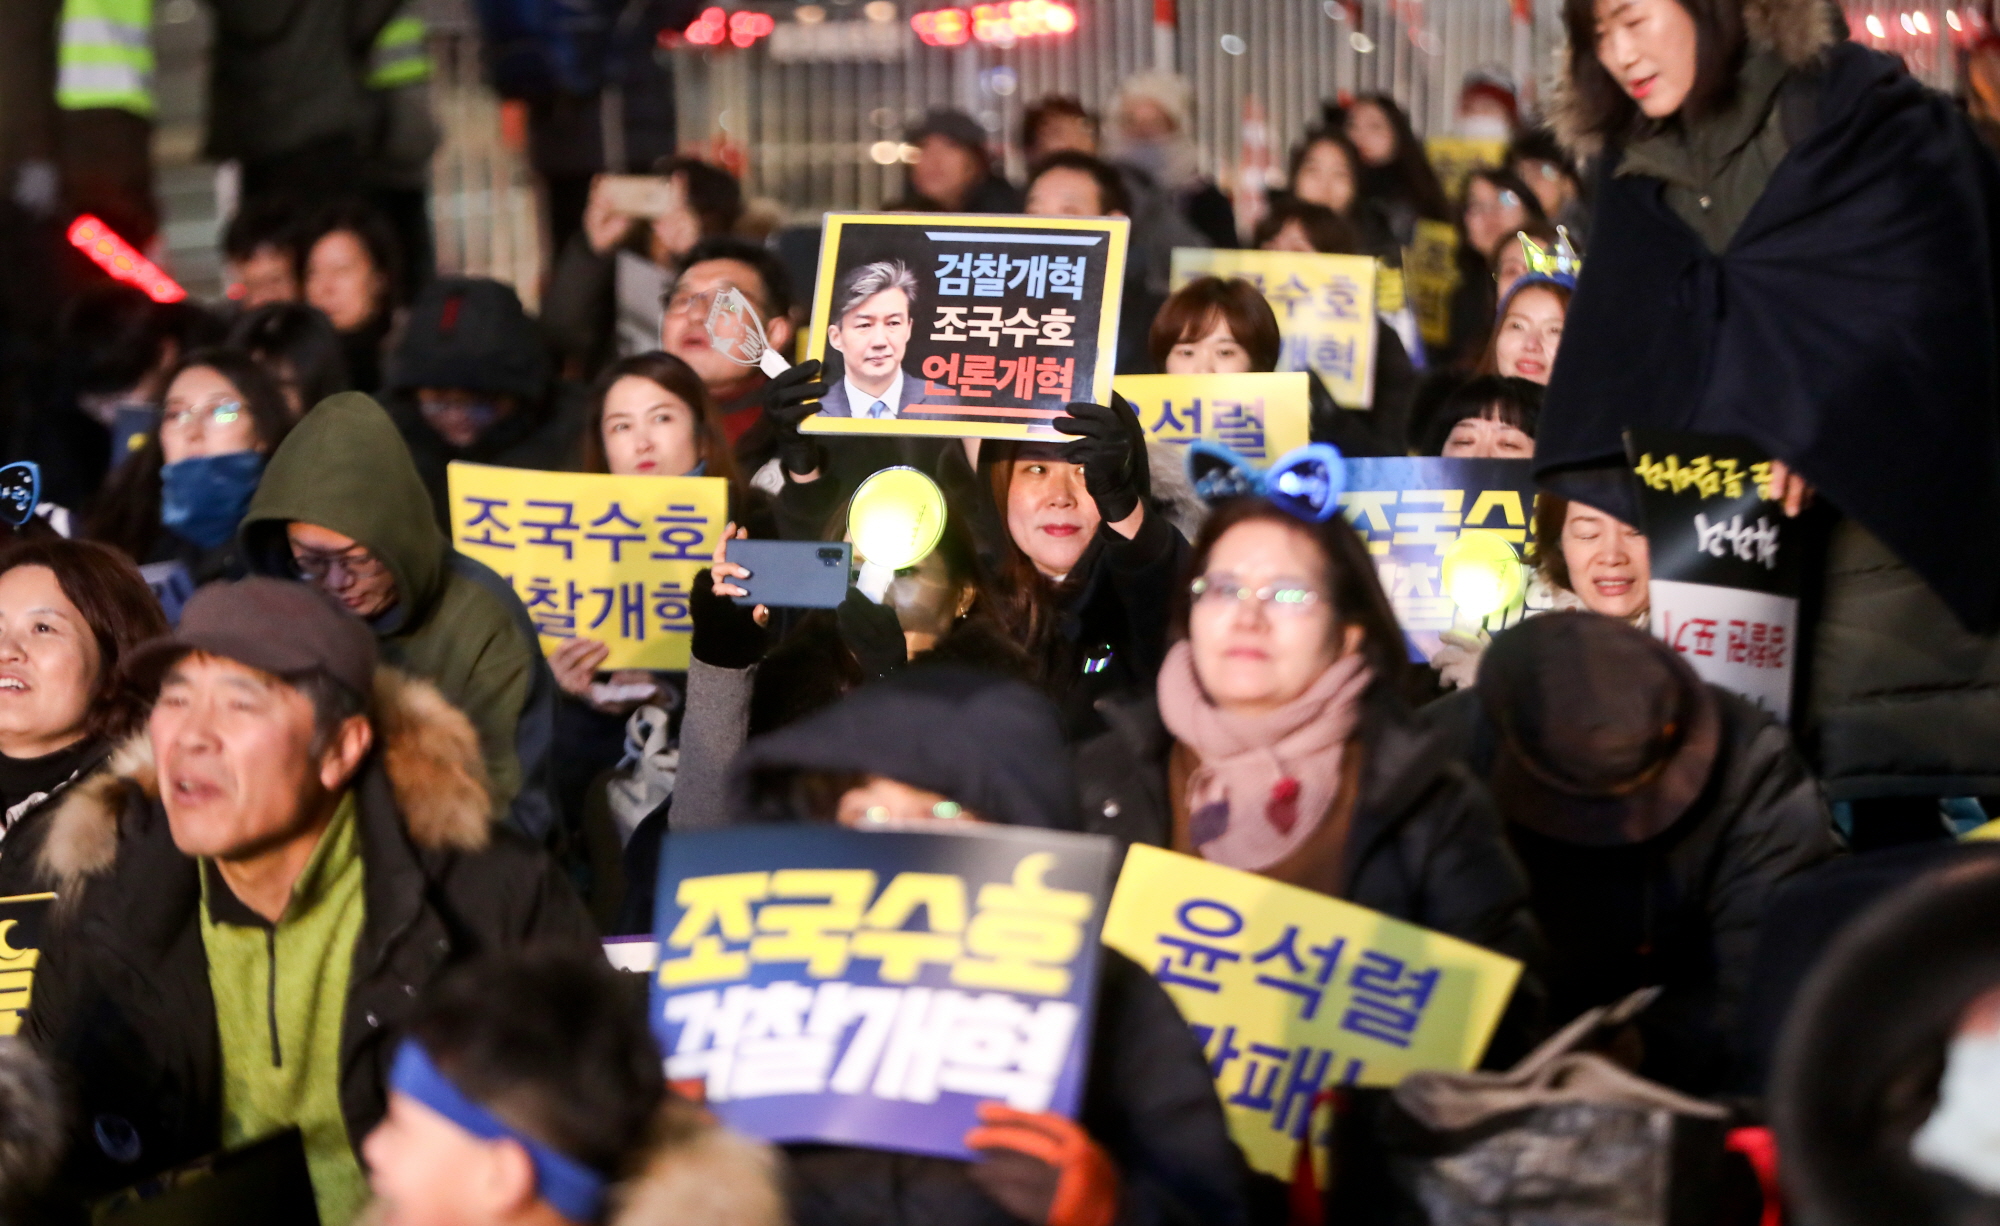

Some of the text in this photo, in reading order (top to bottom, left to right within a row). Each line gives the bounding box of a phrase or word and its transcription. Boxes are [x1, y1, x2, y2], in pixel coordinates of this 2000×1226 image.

[934, 252, 1087, 300] 검찰개혁
[929, 306, 1077, 348] 조국수호
[921, 352, 1075, 402] 언론개혁
[1125, 397, 1267, 458] 석렬
[460, 496, 714, 563] 조국수호
[1338, 488, 1540, 556] 조국수
[656, 852, 1096, 998] 조국수호
[1153, 898, 1442, 1049] 윤석렬
